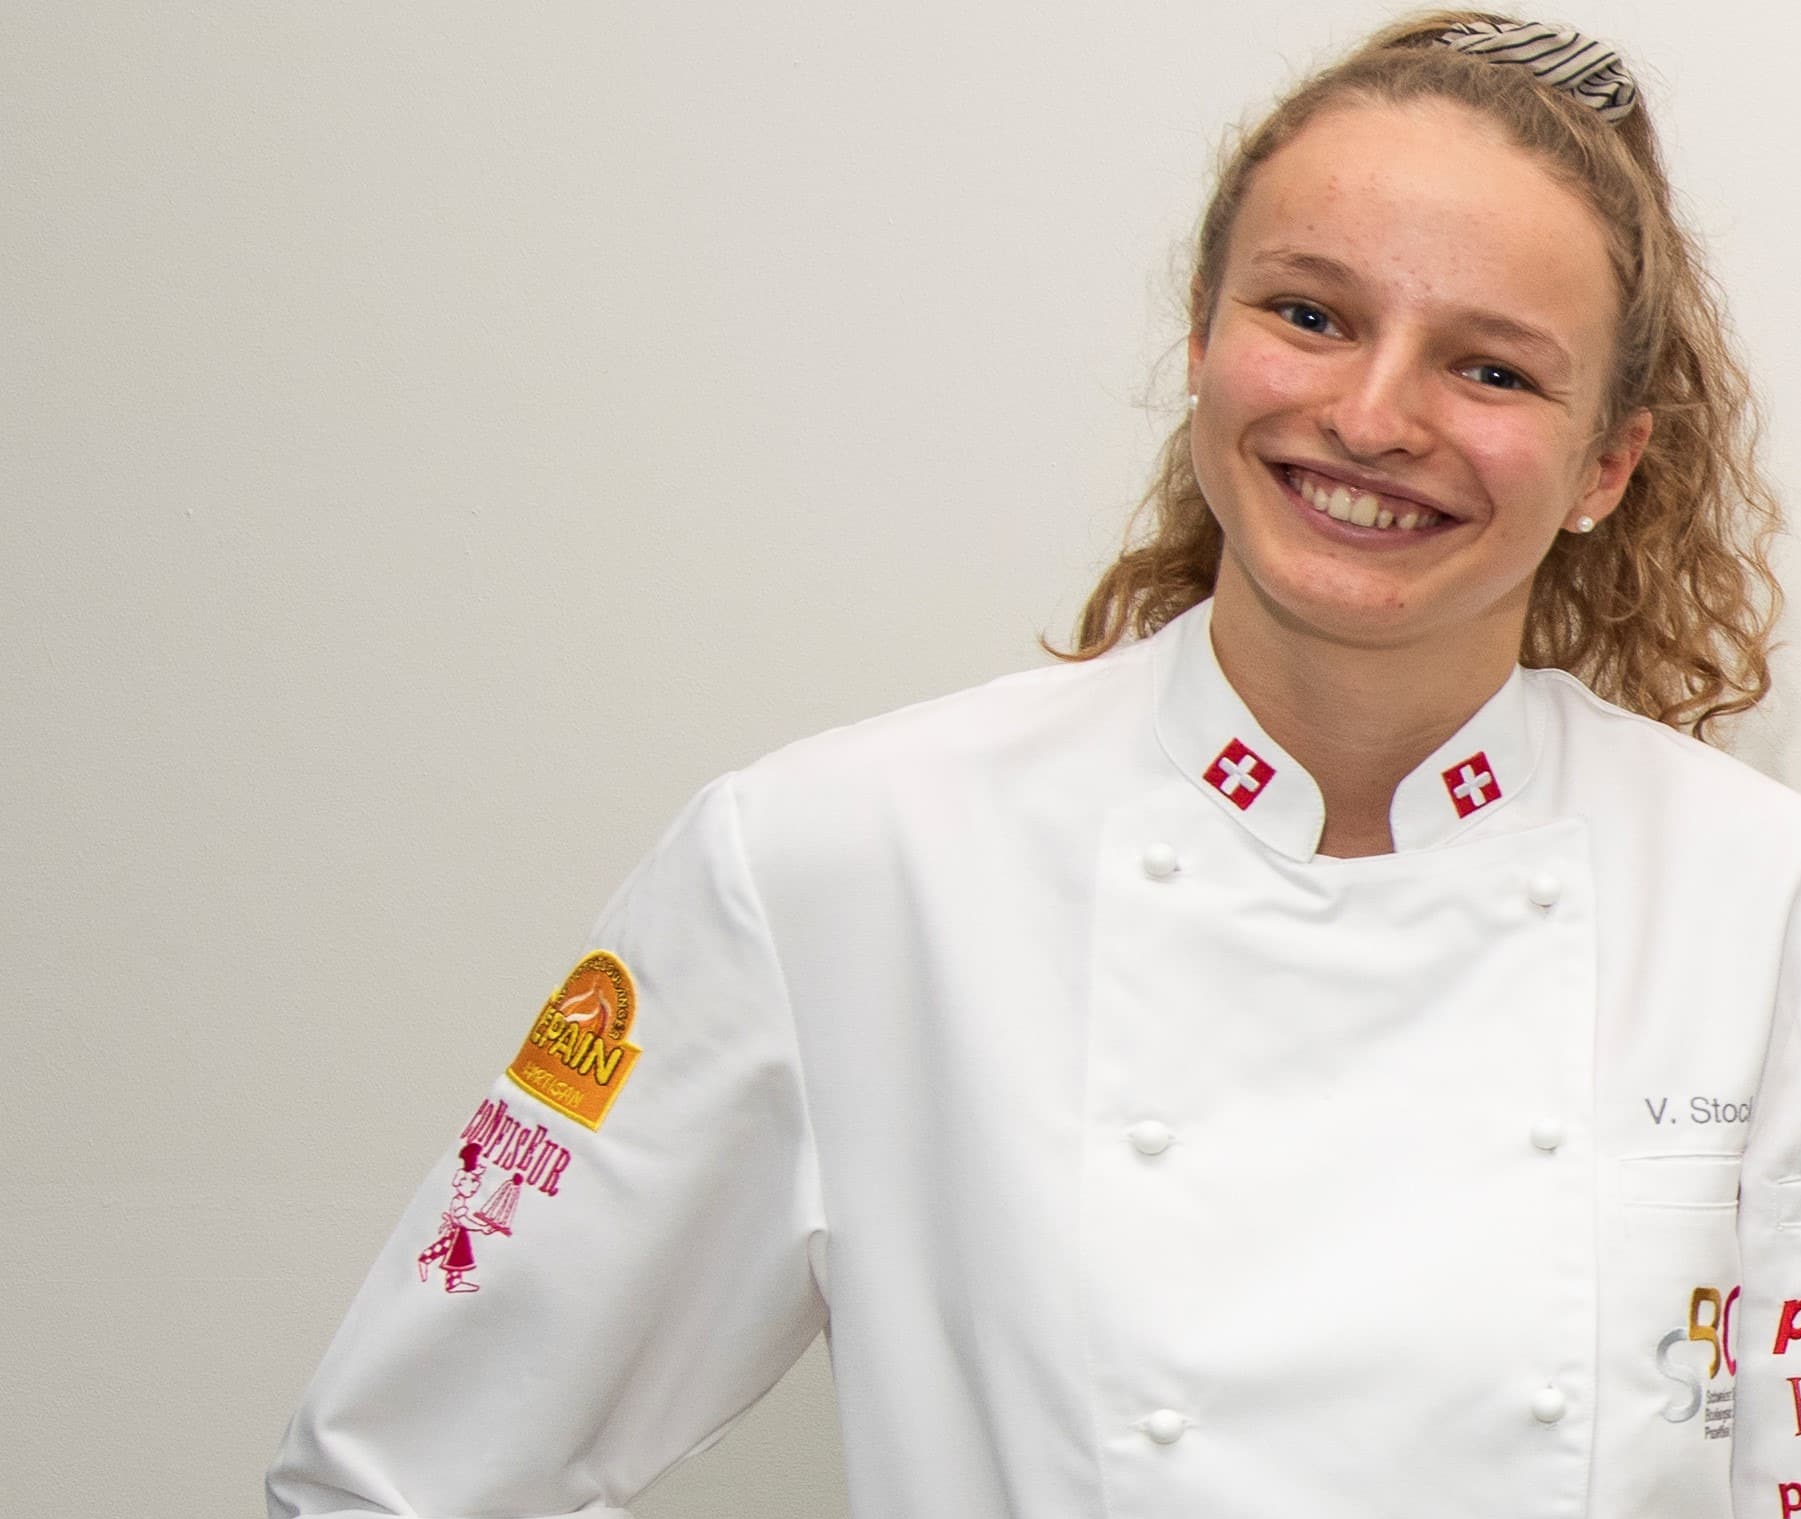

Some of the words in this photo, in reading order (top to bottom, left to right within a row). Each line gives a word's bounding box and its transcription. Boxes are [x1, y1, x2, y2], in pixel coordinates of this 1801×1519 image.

[1645, 1097, 1676, 1125] V.
[1690, 1096, 1755, 1125] Stoc
[460, 1099, 572, 1197] CONFISEUR
